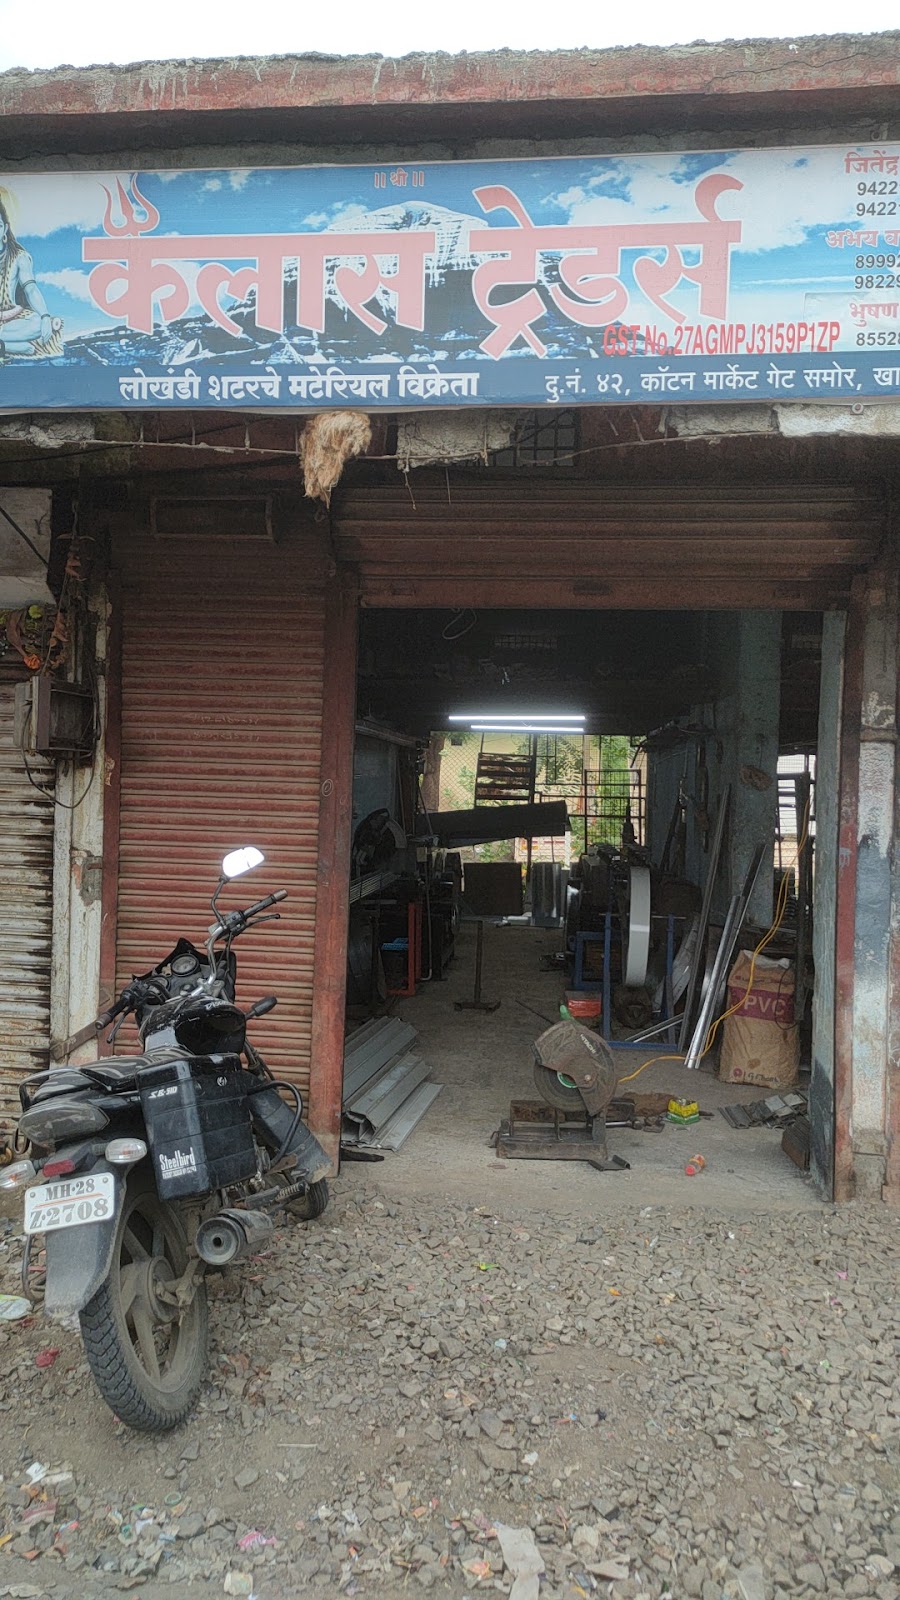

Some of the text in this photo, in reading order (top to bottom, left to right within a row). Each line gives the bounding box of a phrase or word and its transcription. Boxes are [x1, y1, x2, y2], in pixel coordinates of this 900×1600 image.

[844, 149, 900, 176] जितेंद्र
[390, 167, 408, 187] श्री
[857, 181, 900, 196] 9422
[856, 201, 900, 216] 9422
[826, 229, 879, 249] अभय
[468, 172, 745, 362] ट्रेडर्स
[603, 324, 641, 356] GST
[855, 331, 900, 346] 8552
[118, 367, 201, 400] लोखंडी
[208, 366, 282, 401] शटरचे
[288, 366, 391, 399] मटेरियल
[397, 364, 480, 399] विक्रेता
[640, 365, 696, 392] कॉटन
[702, 363, 760, 390] मार्केट
[766, 362, 796, 389] गेट
[803, 361, 862, 391] समोर,
[744, 994, 786, 1017] PVC
[159, 1146, 196, 1170] Steelbird
